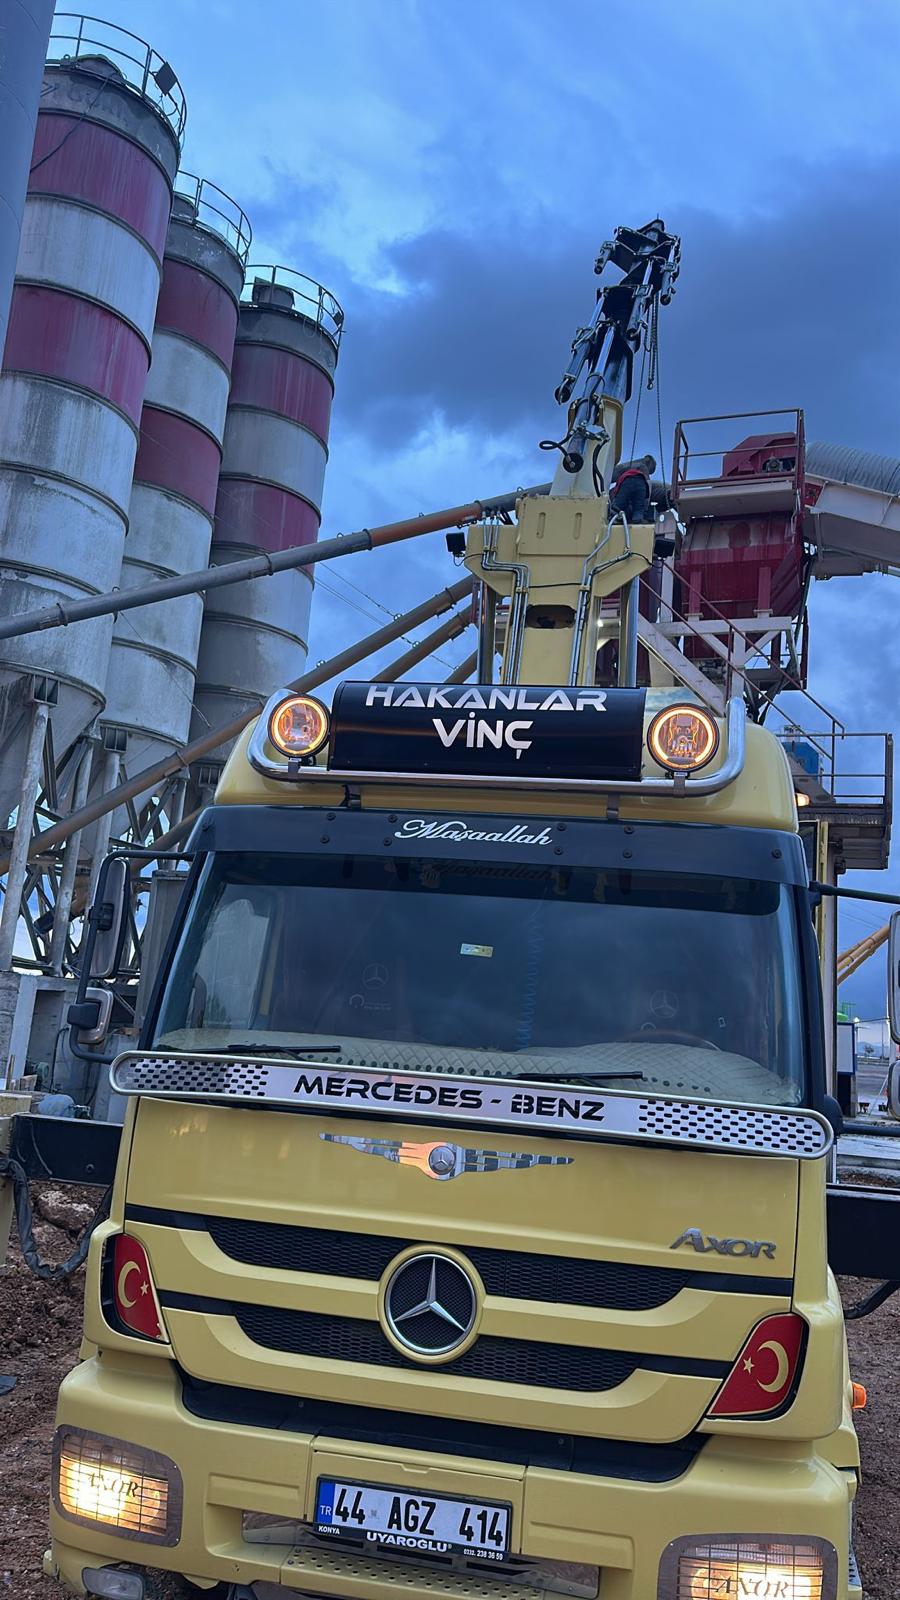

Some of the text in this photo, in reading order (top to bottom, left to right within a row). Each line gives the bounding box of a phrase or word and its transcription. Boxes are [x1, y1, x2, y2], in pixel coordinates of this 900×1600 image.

[365, 686, 607, 711] HAKANLAR
[432, 711, 534, 760] VİNÇ
[394, 819, 553, 846] Maşaallah
[293, 1074, 483, 1109] MERCEDES
[511, 1093, 605, 1121] BENZ
[669, 1227, 777, 1259] AXOR
[320, 1504, 331, 1516] TR
[335, 1488, 504, 1546] 44 AGZ 414
[318, 1525, 340, 1535] KONYA
